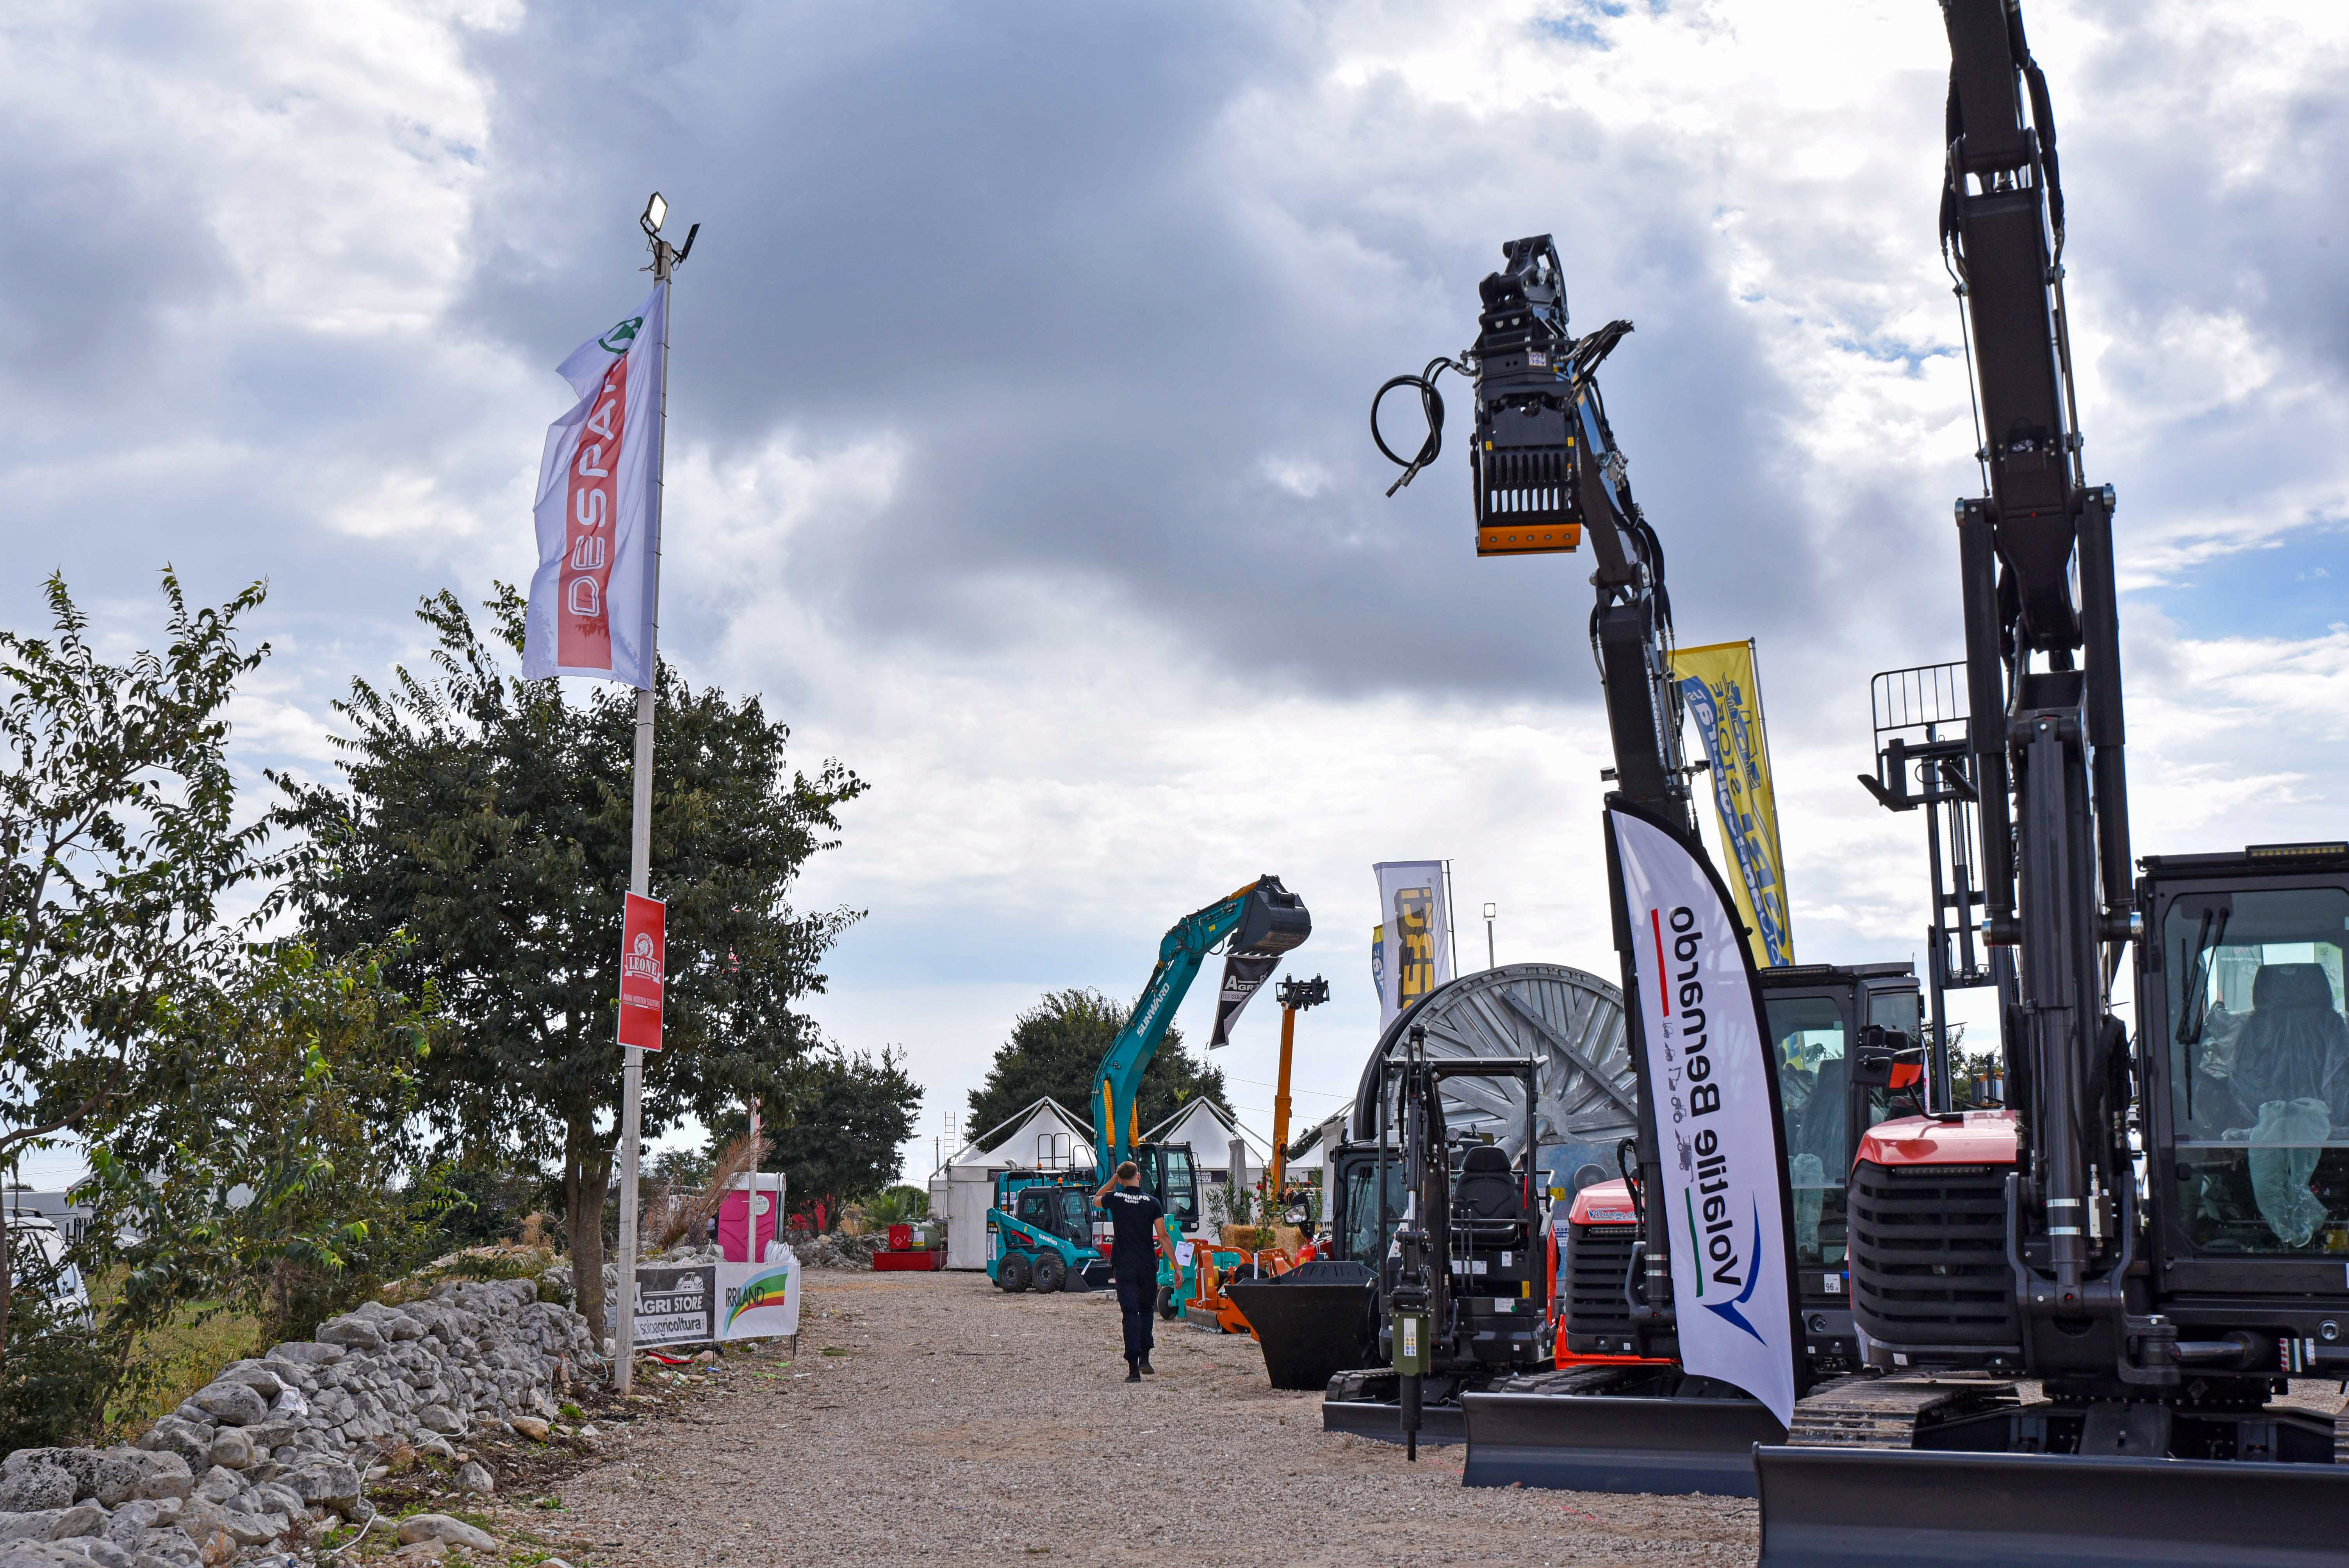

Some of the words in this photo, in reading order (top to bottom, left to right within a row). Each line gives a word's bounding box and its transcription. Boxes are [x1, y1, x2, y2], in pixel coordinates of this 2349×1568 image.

[629, 957, 657, 975] LEONE
[1224, 975, 1255, 991] AGR
[1137, 983, 1170, 1037] SUNWARD
[1114, 1192, 1150, 1201] MONDIALPOL
[674, 1295, 702, 1312] STORE
[725, 1285, 765, 1307] IRRILAND
[634, 1316, 702, 1336] onsoloagricoltura
